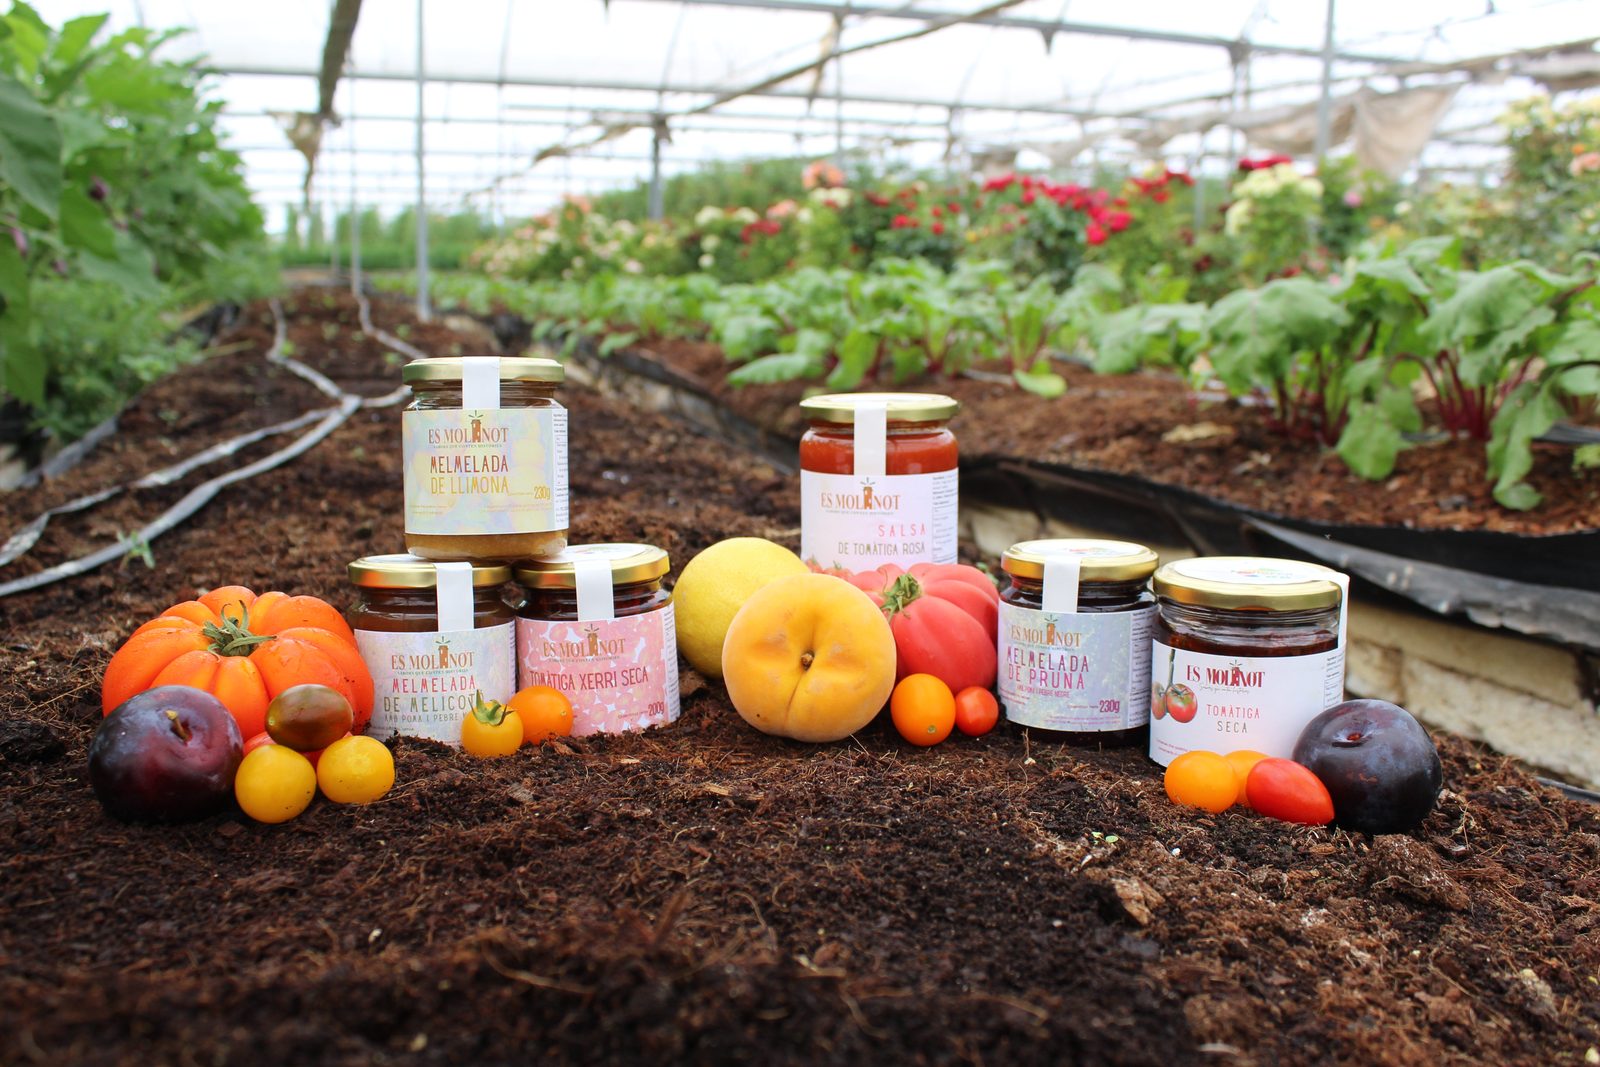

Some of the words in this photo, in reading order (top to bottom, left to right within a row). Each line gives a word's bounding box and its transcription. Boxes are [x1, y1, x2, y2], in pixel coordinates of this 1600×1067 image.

[428, 429, 440, 444] ES
[430, 455, 508, 473] MELMELADA
[431, 477, 444, 494] DE
[450, 476, 509, 494] LLIMONA
[821, 492, 832, 508] ES
[878, 523, 926, 537] SALSA
[838, 542, 848, 555] DE
[854, 541, 898, 556] TOMÀTIGA
[903, 542, 925, 555] ROSA
[1011, 624, 1020, 640] ES
[543, 642, 556, 657] ES
[391, 654, 406, 670] ES
[1007, 646, 1088, 672] MELMELADA
[580, 671, 618, 690] XERRI
[621, 666, 648, 686] SECA
[1008, 664, 1021, 682] DE
[1030, 668, 1084, 690] PRUNA
[1187, 665, 1200, 682] ES
[392, 675, 476, 693] MELMELADA
[384, 696, 400, 712] DE
[1100, 700, 1120, 713] 230g
[1206, 704, 1260, 718] TOMÀTIGA
[1217, 721, 1247, 733] SECA
